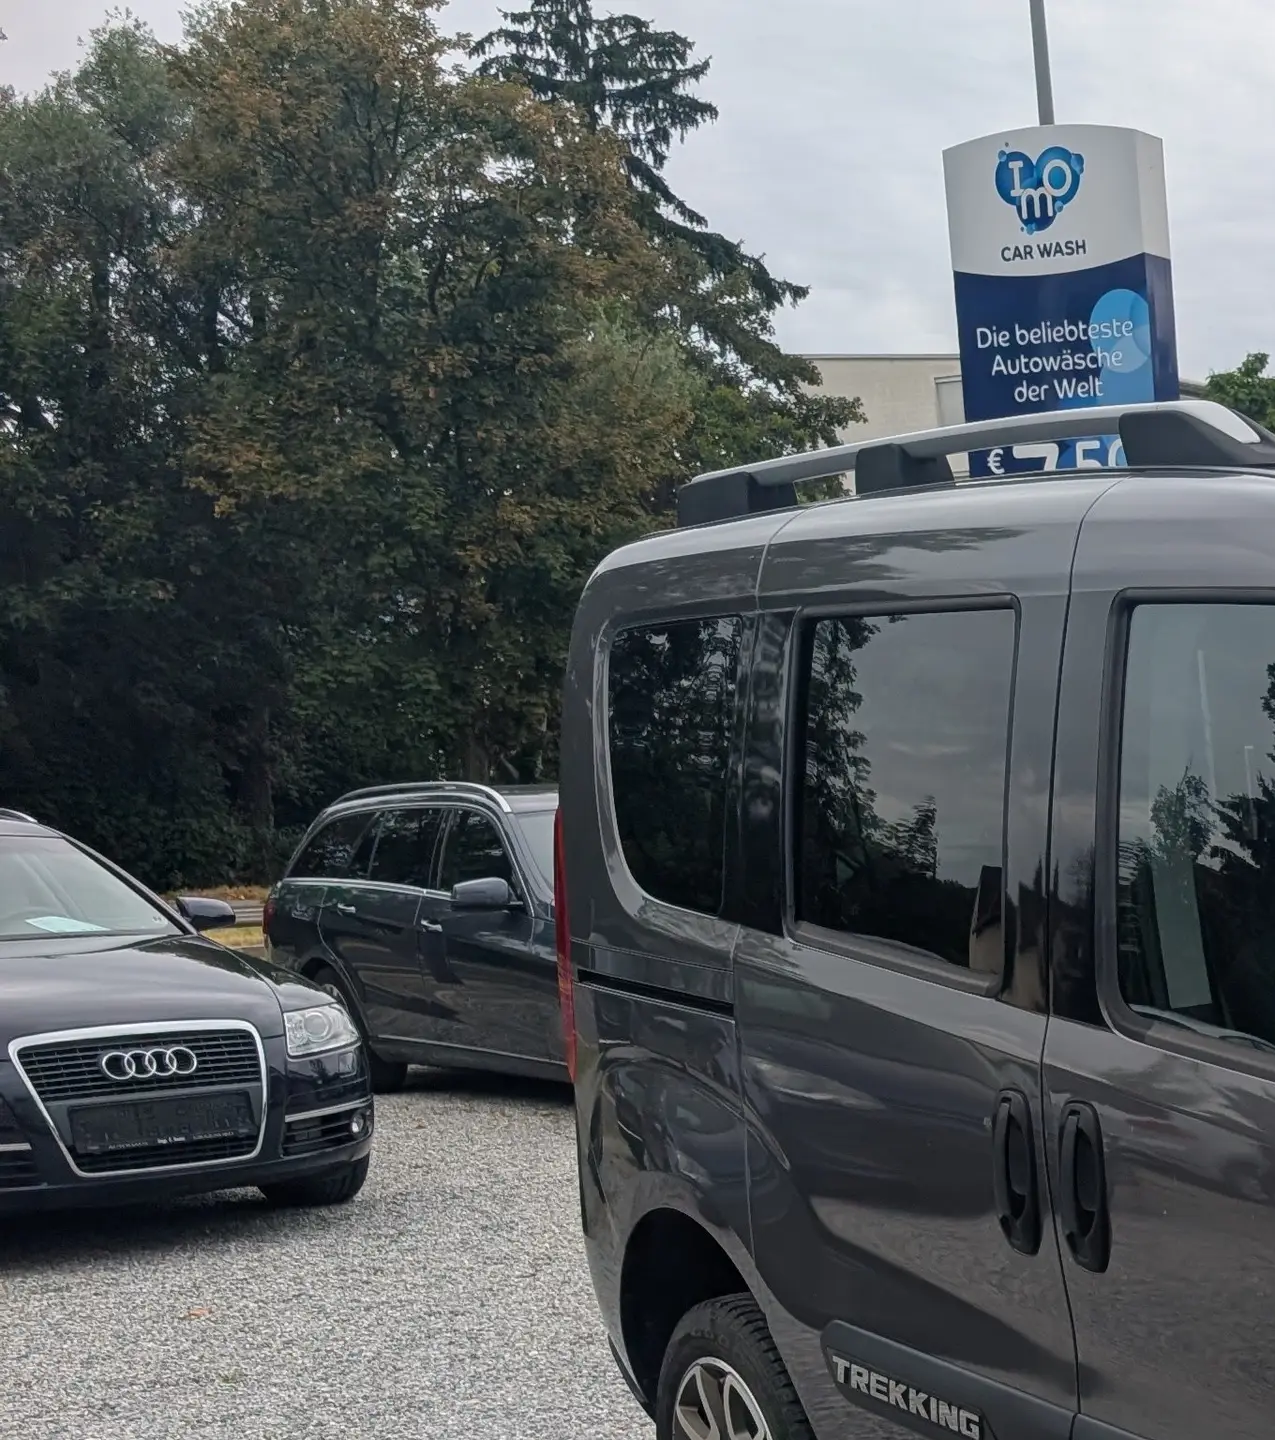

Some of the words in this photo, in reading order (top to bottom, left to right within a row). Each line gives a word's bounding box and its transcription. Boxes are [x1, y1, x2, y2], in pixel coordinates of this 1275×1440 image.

[1000, 245, 1033, 262] CAR
[1037, 240, 1087, 259] WASH
[976, 326, 1010, 349] Die
[1015, 319, 1134, 346] beliebteste
[991, 348, 1123, 377] Autowäsche
[1014, 384, 1050, 403] der
[1054, 378, 1104, 400] Welt
[832, 1355, 980, 1440] TREKKING
